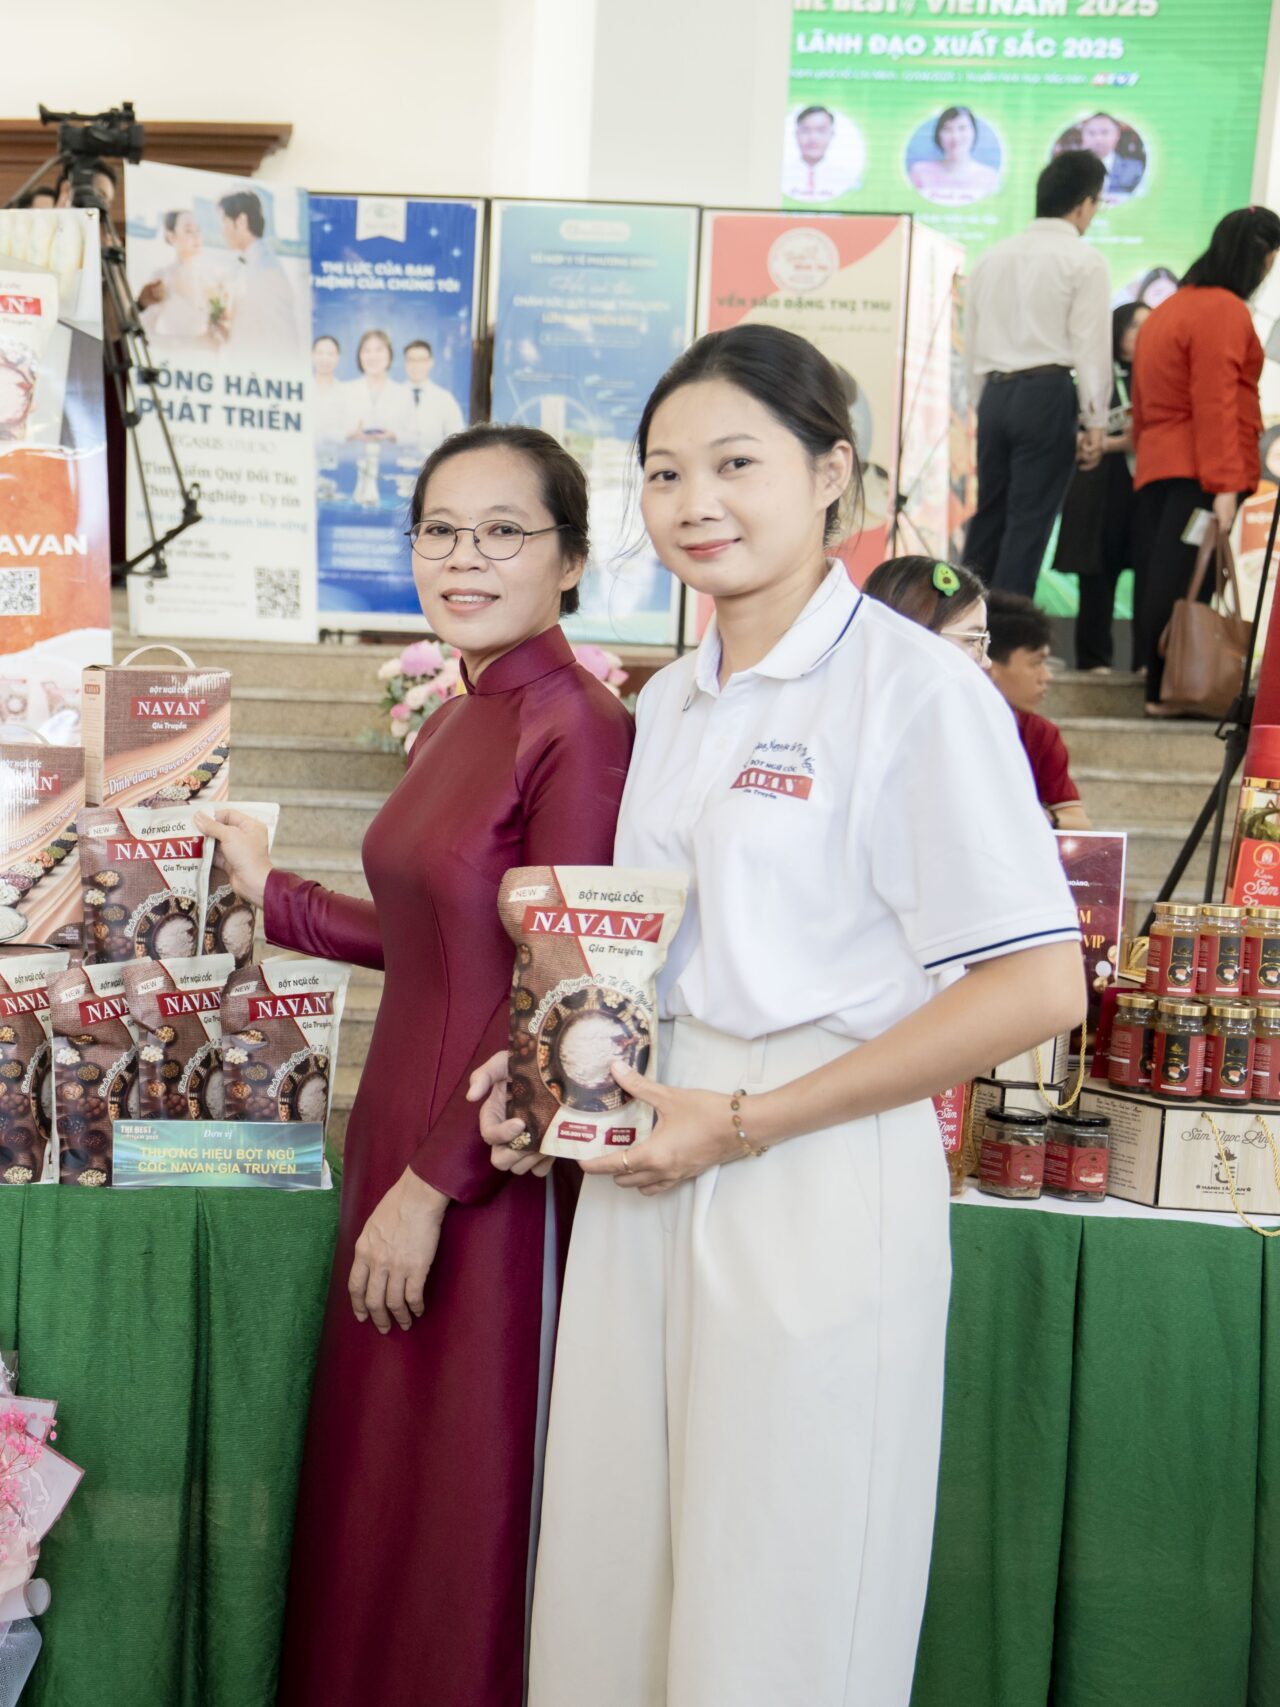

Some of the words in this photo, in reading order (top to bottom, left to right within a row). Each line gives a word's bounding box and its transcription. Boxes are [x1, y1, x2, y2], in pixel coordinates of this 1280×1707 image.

[925, 0, 1066, 16] VIETNAM
[1074, 0, 1158, 17] 2025
[797, 28, 861, 54] LÃNH
[868, 33, 926, 61] ĐẠO
[933, 27, 999, 58] XUẤT
[1004, 29, 1056, 58] SẮC
[1062, 37, 1125, 59] 2025
[225, 372, 304, 402] HÀNH
[139, 396, 212, 424] PHÁT
[223, 404, 302, 432] TRIỂN
[137, 701, 200, 715] NAVAN
[94, 826, 110, 834] NEW
[115, 840, 193, 860] NAVAN
[516, 888, 537, 897] NEW
[578, 890, 599, 902] BỘT
[600, 892, 621, 902] NGŨ
[623, 890, 644, 903] CỐC
[529, 911, 646, 938] NAVAN
[1083, 935, 1106, 949] VIP
[588, 943, 605, 953] Gia
[608, 945, 644, 957] Truyền
[141, 981, 157, 991] NEW
[235, 984, 251, 993] NEW
[278, 979, 291, 989] BỘT
[256, 996, 327, 1019] NAVAN
[136, 1126, 152, 1134] BEST
[1181, 1127, 1210, 1141] Sâm
[140, 1145, 199, 1160] THƯƠNG
[266, 1146, 296, 1161] NGŨ
[170, 1161, 216, 1174] NAVAN
[219, 1162, 242, 1175] GIA
